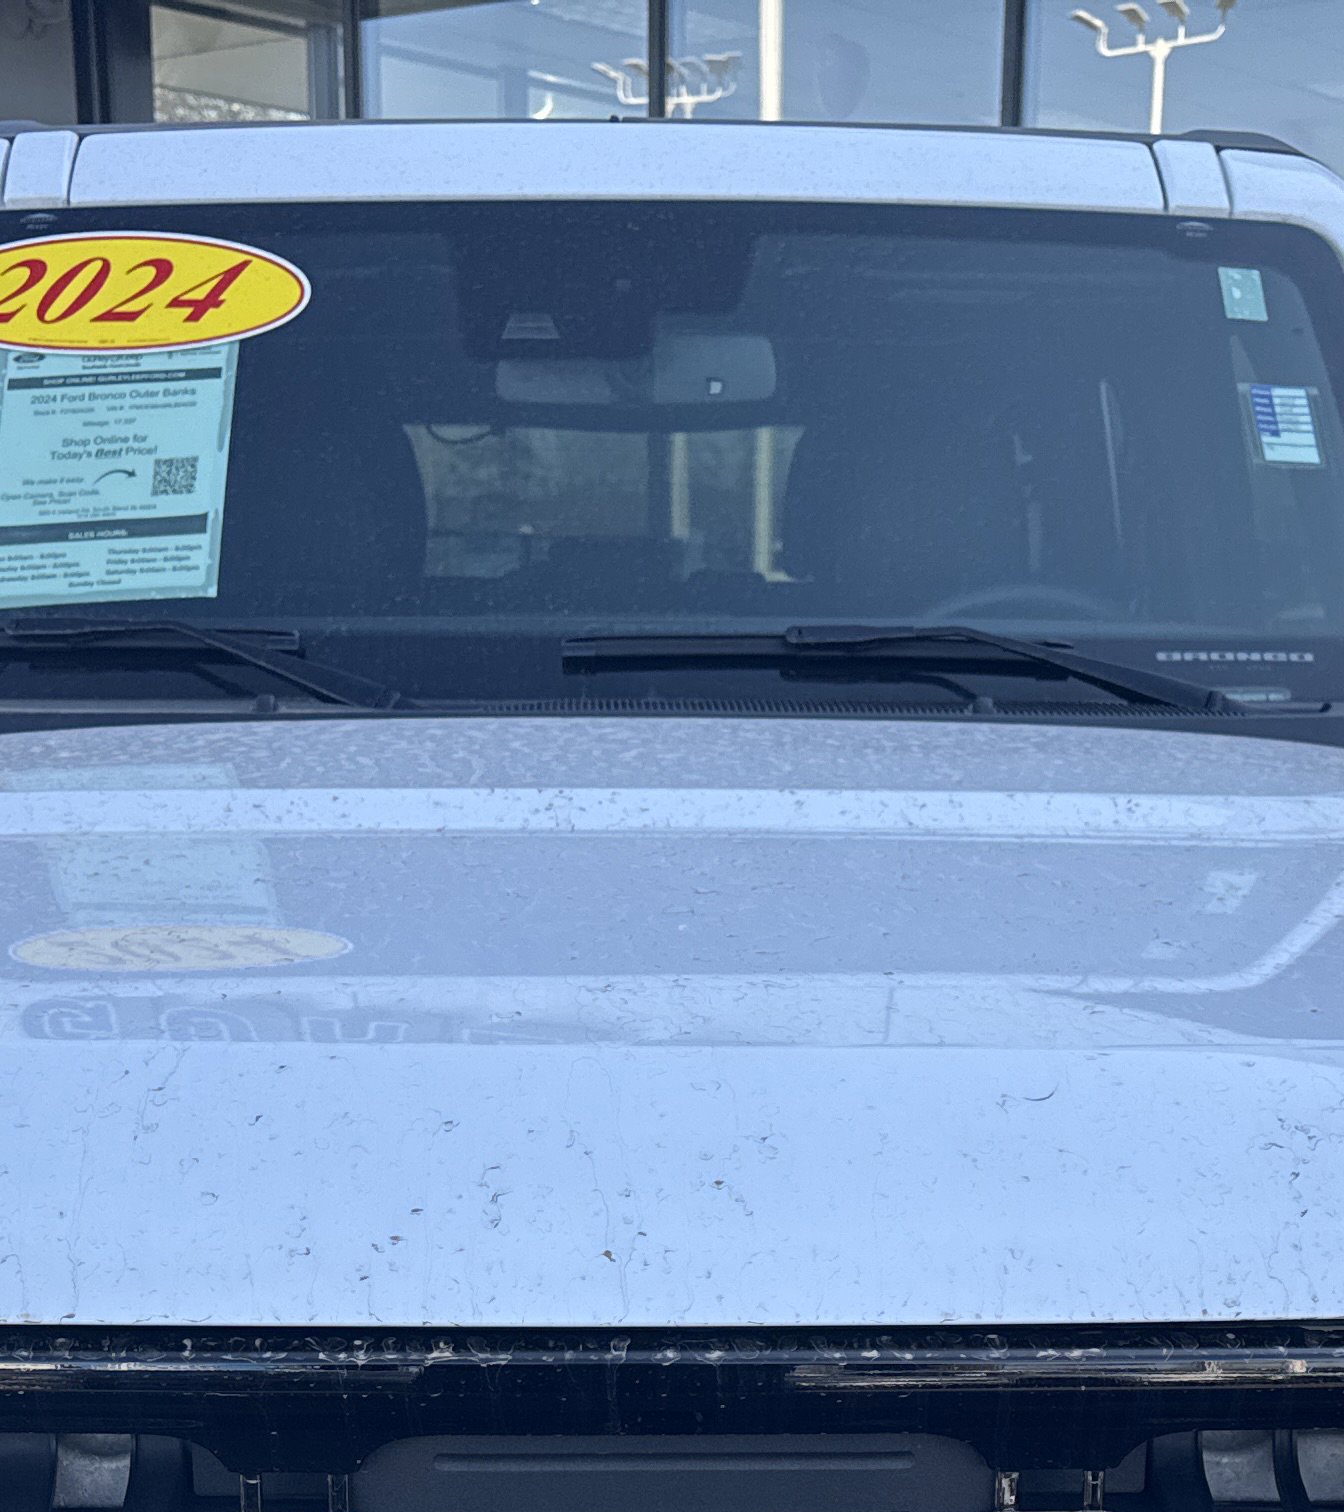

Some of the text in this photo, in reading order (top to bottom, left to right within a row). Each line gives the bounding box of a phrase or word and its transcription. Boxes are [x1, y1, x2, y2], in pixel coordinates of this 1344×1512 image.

[30, 387, 197, 405] 2024 Ford Bronco Outer Banks
[61, 433, 149, 448] Shop Online for
[50, 445, 158, 462] Today's Best Price!
[67, 530, 96, 541] SALES
